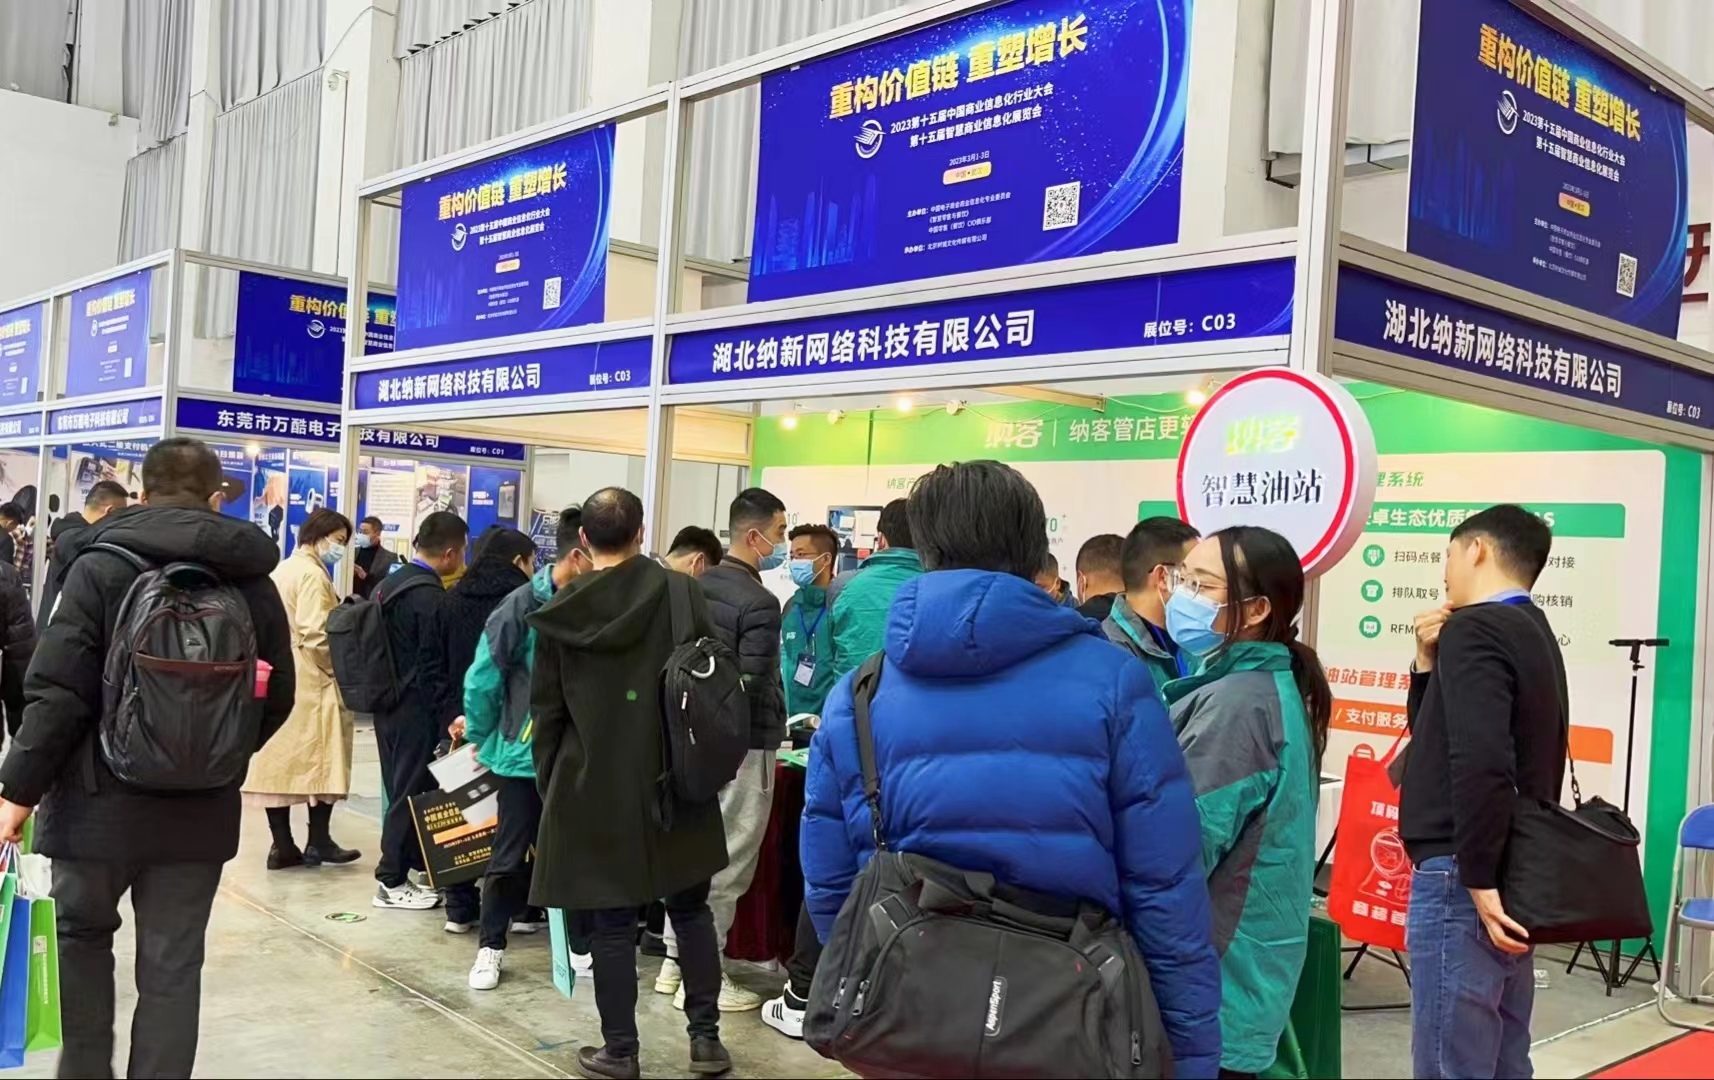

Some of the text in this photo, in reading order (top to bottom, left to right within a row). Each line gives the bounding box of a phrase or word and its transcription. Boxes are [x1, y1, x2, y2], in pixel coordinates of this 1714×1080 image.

[829, 13, 1088, 119] 重构价值链 重塑增长
[1478, 23, 1641, 142] 重构价值链 重塑增长
[890, 82, 1054, 134] 2023第十五届中国商业信息化行业大会
[909, 103, 1042, 147] 第十五届智慧商业信息化展览会
[439, 161, 567, 220] 重构价值链 重塑增长
[712, 309, 1236, 374] 湖北纳新网络科技有限公司 展位号：C03
[1383, 299, 1622, 398] 湖北纳新网络科技有限公司
[378, 363, 541, 402] 湖北纳新网络科技有限公司
[1202, 468, 1323, 508] 智慧油站
[1394, 551, 1442, 563] 扫码点餐
[1544, 556, 1576, 569] 对接
[1392, 587, 1439, 600] 排队取号
[1345, 708, 1408, 729] 支付服务
